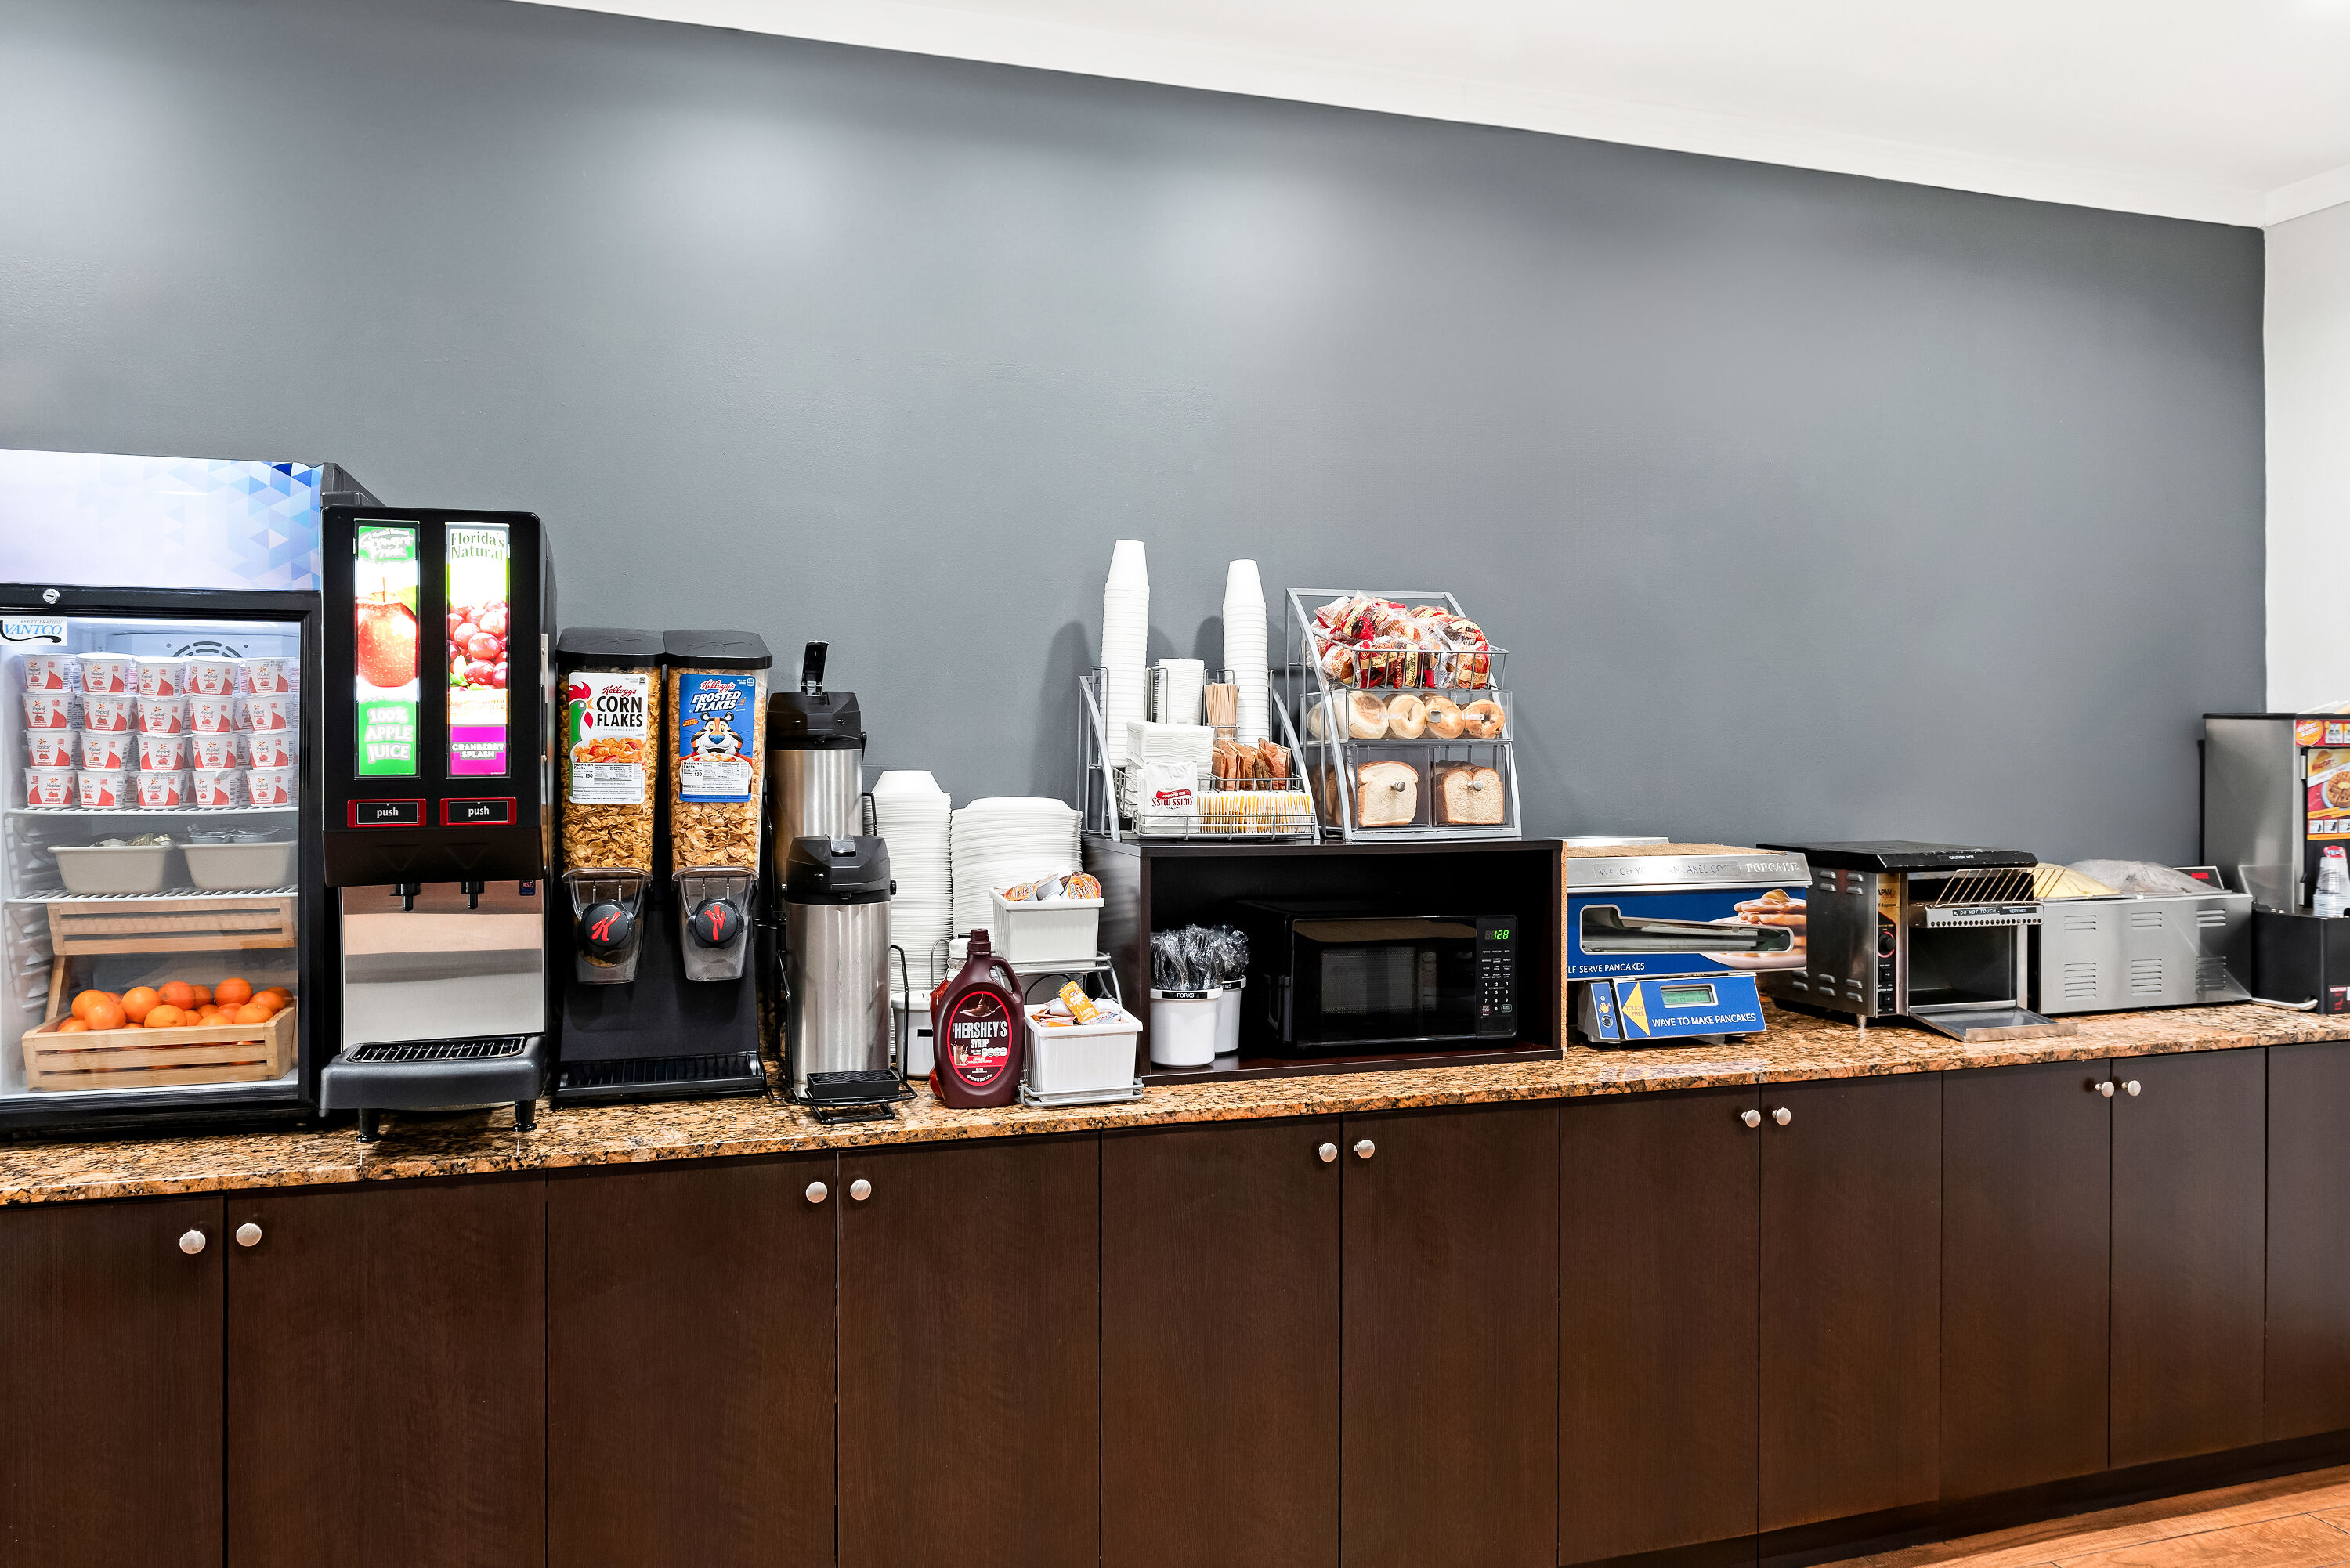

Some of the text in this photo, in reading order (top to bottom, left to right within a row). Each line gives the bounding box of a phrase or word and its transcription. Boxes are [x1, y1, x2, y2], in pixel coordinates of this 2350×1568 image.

[451, 531, 504, 547] Florida's
[451, 545, 503, 561] Natural
[2, 623, 62, 635] VANTCO
[602, 685, 637, 697] Kellogg's
[700, 679, 735, 692] Kellogg's
[597, 695, 642, 713] CORN
[692, 690, 742, 704] FROSTED
[694, 699, 736, 713] FLAKES
[369, 707, 407, 723] 100%
[597, 713, 642, 728] FLAKES
[366, 725, 413, 742] APPLE
[367, 743, 410, 763] JUICE
[451, 742, 506, 752] CRANBERRY
[377, 807, 399, 818] push
[468, 806, 490, 817] push
[1745, 862, 1799, 872] POPCAKE
[1495, 930, 1509, 940] 128
[1567, 963, 1645, 974] LF-SERVE PANCAKES
[1652, 1013, 1756, 1027] WAVE TO MAKE PANCAKES
[954, 1021, 1007, 1039] HERSHEY'S
[971, 1039, 989, 1048] SYRUP
